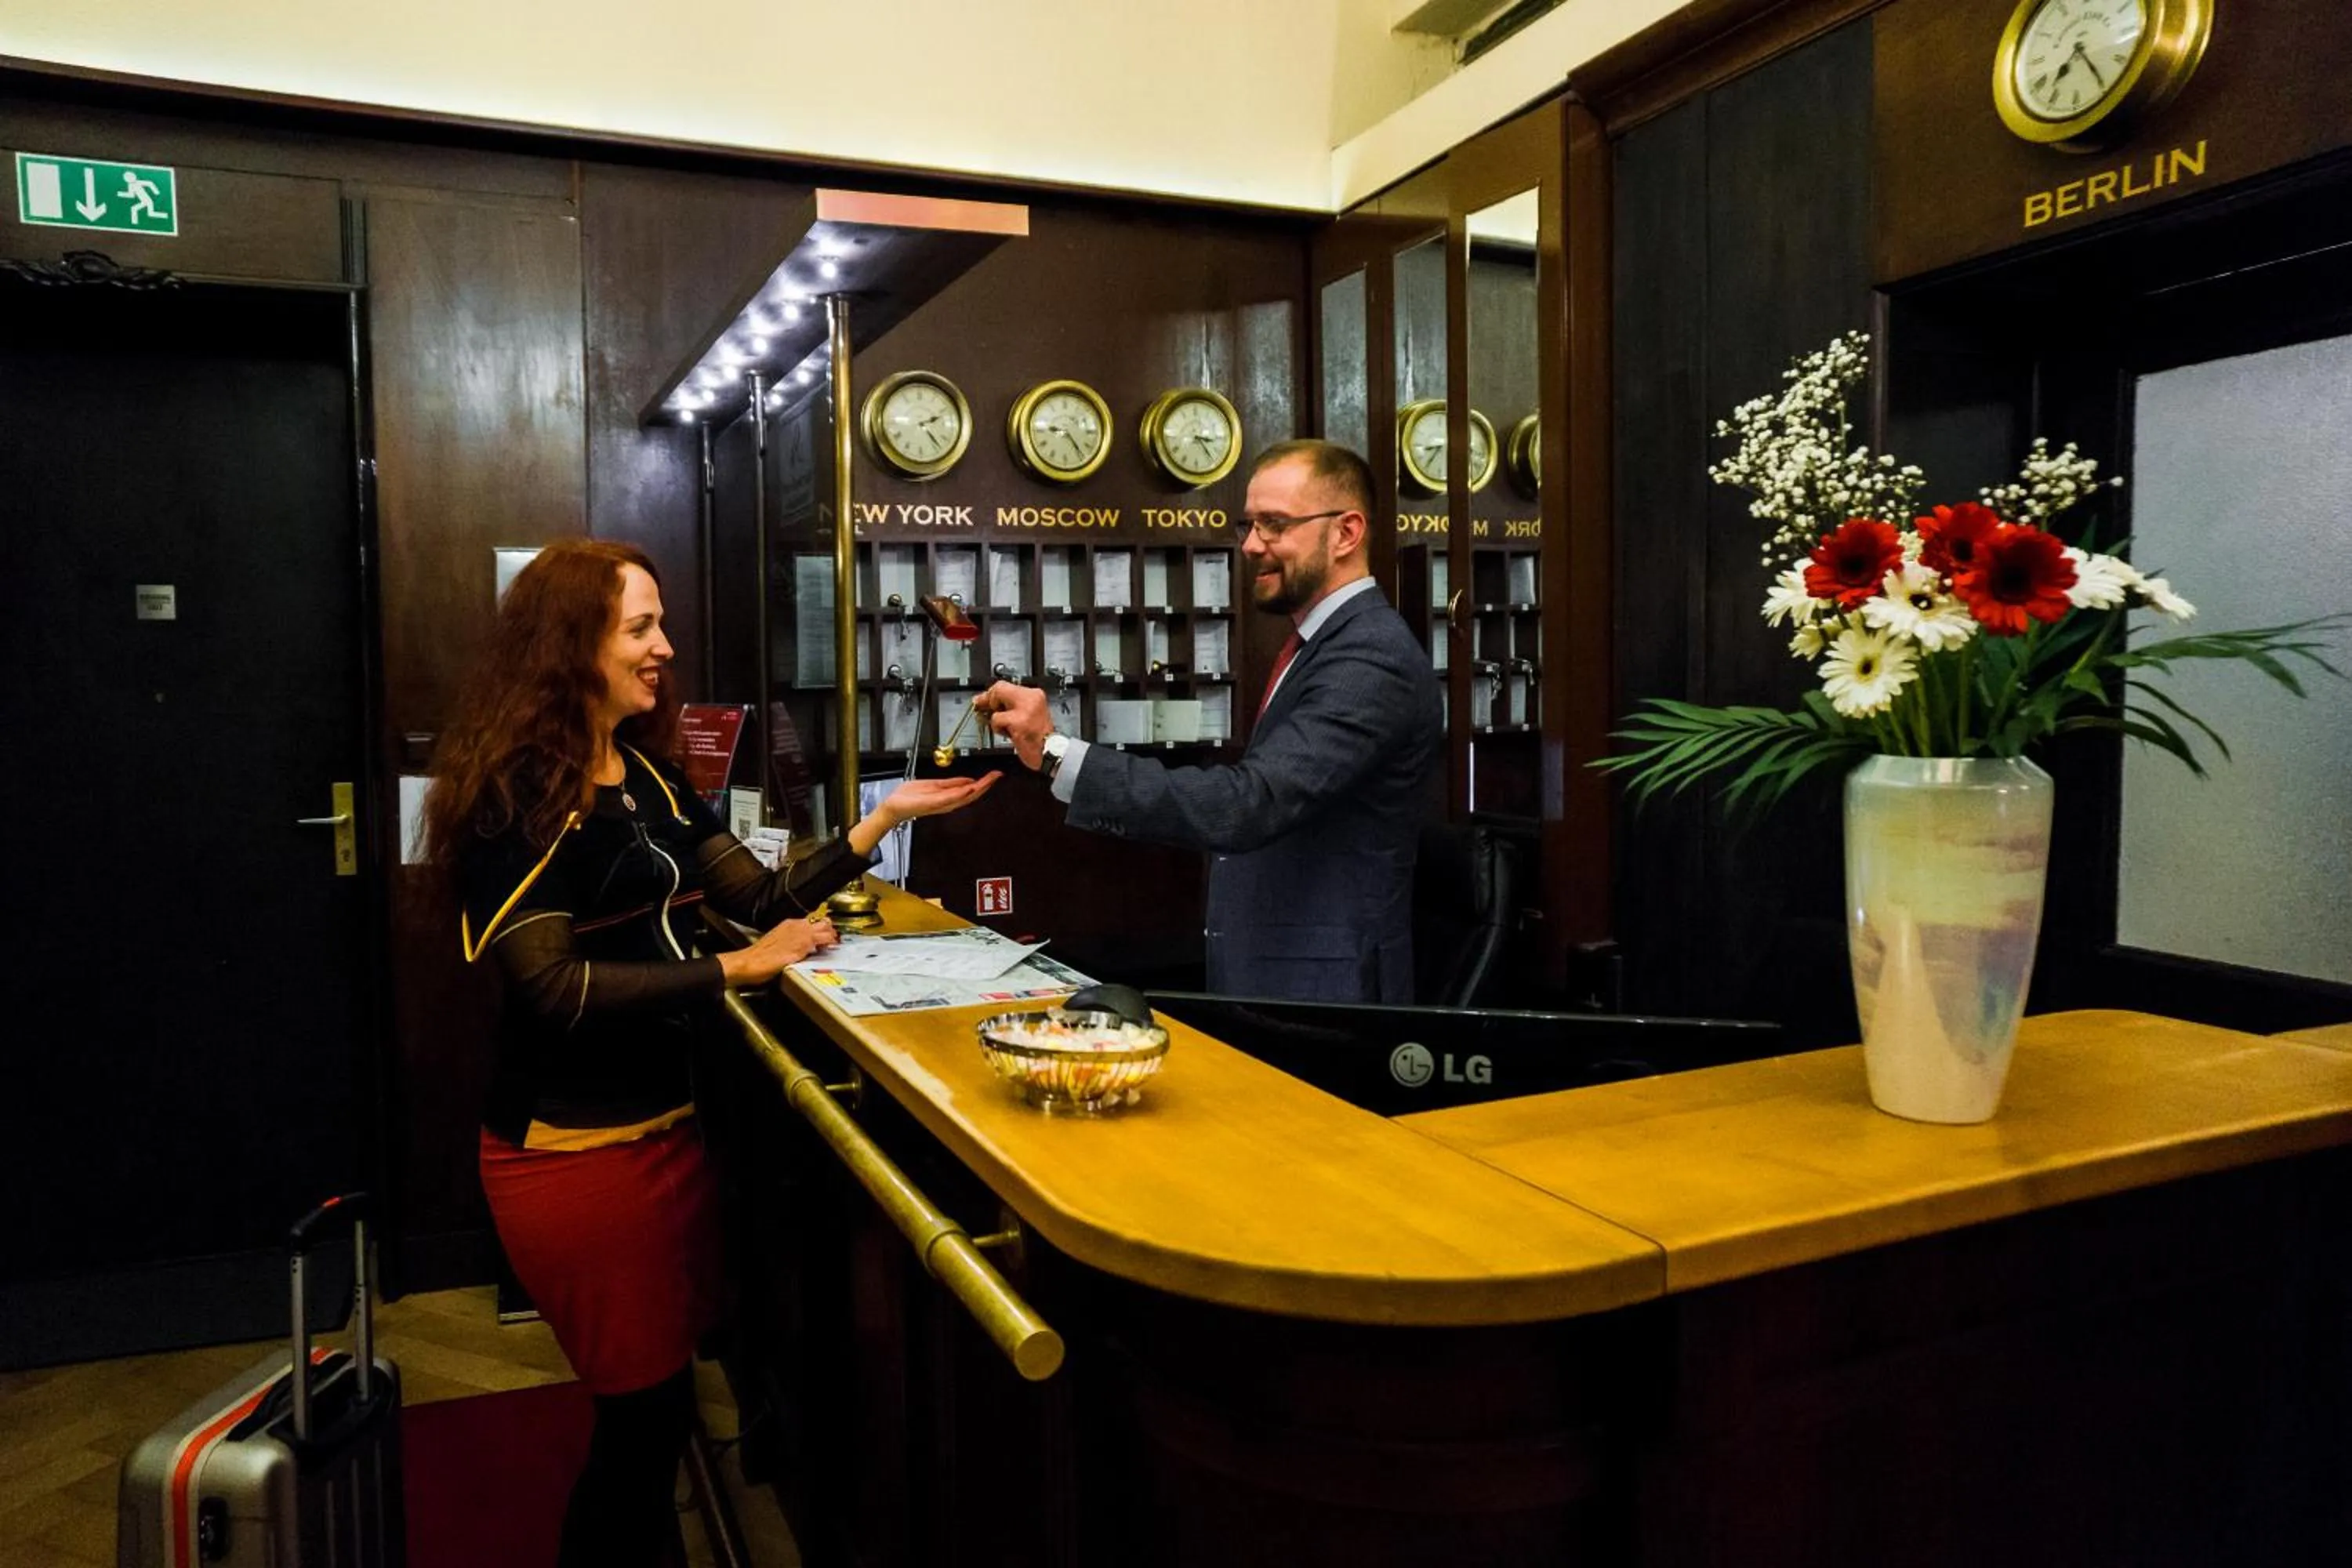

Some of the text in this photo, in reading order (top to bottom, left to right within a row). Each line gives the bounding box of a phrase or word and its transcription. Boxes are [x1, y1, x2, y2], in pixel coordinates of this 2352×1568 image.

[2024, 140, 2208, 227] BERLIN
[896, 505, 974, 526] YORK
[996, 507, 1120, 528] MOSCOW
[1142, 508, 1227, 528] TOKYO
[1443, 1053, 1493, 1083] LG
